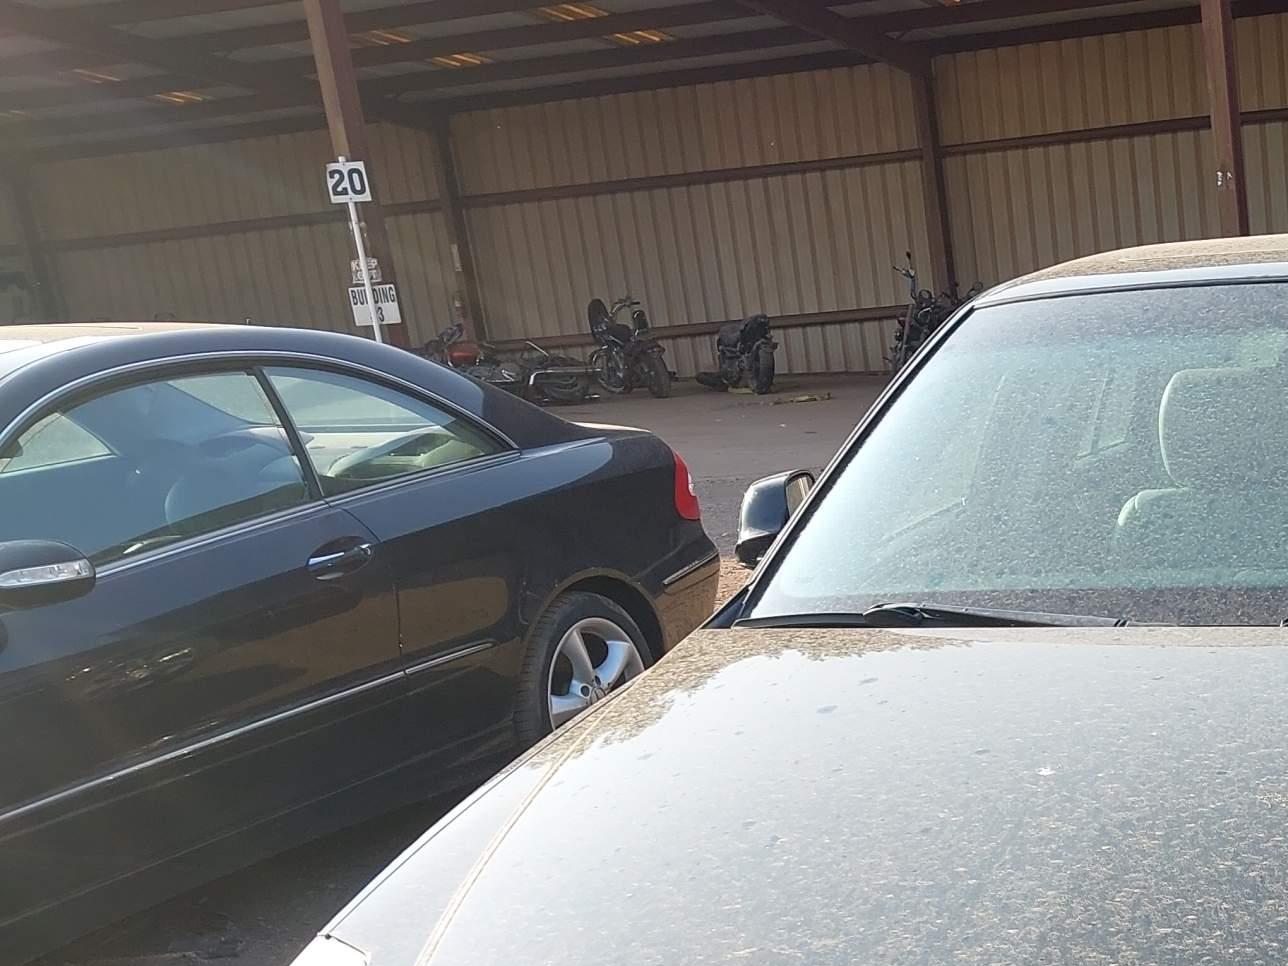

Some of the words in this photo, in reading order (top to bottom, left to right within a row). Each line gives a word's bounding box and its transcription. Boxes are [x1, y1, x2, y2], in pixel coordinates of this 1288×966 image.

[328, 168, 366, 196] 20
[351, 257, 378, 272] KP
[351, 287, 396, 306] BUIDING
